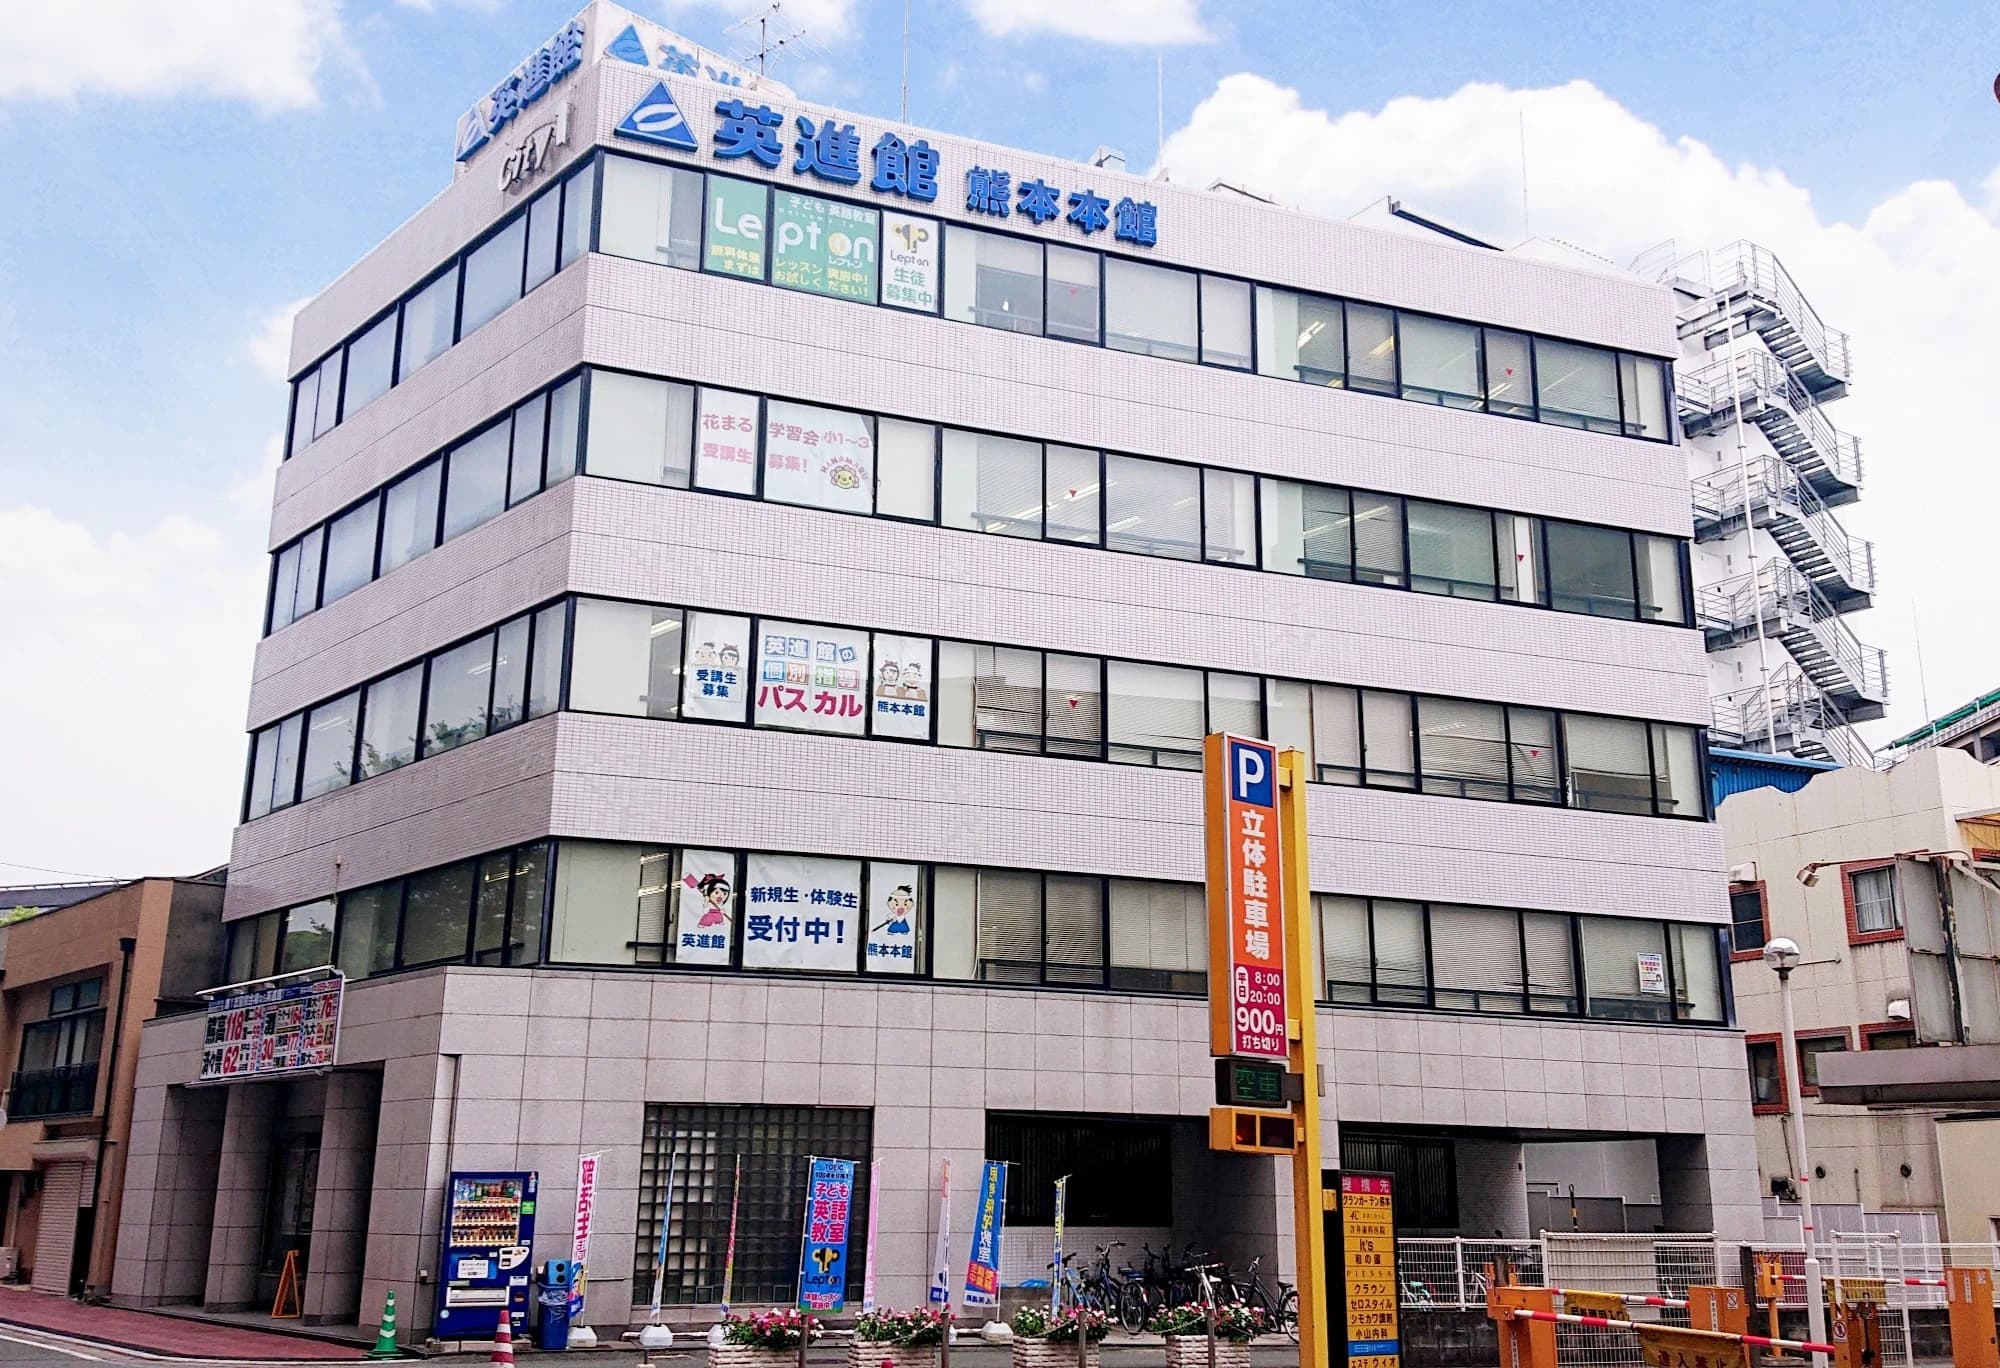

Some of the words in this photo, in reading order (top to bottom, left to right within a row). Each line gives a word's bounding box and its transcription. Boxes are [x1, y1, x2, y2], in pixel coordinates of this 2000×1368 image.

[714, 99, 940, 202] 英進館
[965, 165, 1158, 247] 熊本本館
[890, 249, 929, 267] Lepton
[894, 267, 926, 287] 生徒
[886, 283, 933, 306] 募集中
[702, 413, 753, 434] 花まる
[768, 421, 820, 447] 学習会
[702, 442, 753, 465] 受講生
[765, 635, 856, 663] 英進館の
[696, 668, 737, 685] 受講生
[763, 660, 860, 691] 個別指導
[702, 683, 729, 698] 募集
[757, 684, 863, 717] パスカル
[877, 700, 926, 717] 熊本本館
[1238, 747, 1265, 798] P
[1240, 808, 1269, 961] 立体駐車場
[750, 886, 858, 909] 新規生・体験生
[681, 932, 726, 949] 英進館
[747, 914, 845, 945] 受付中!
[867, 942, 913, 959] 熊本本館
[1237, 972, 1247, 998] 平日
[1254, 971, 1281, 987] 8:00
[1249, 990, 1281, 1006] 20:00
[1236, 1006, 1284, 1037] 900円
[261, 1037, 275, 1061] 30
[1241, 1034, 1280, 1052] 打ち切り
[223, 1046, 240, 1074] 62
[815, 1181, 849, 1198] 子ども
[813, 1200, 848, 1221] 英語
[811, 1222, 846, 1244] 教室
[805, 1271, 842, 1288] Lepton
[1354, 1283, 1386, 1295] クラウン
[1355, 1327, 1388, 1340] 小山内科
